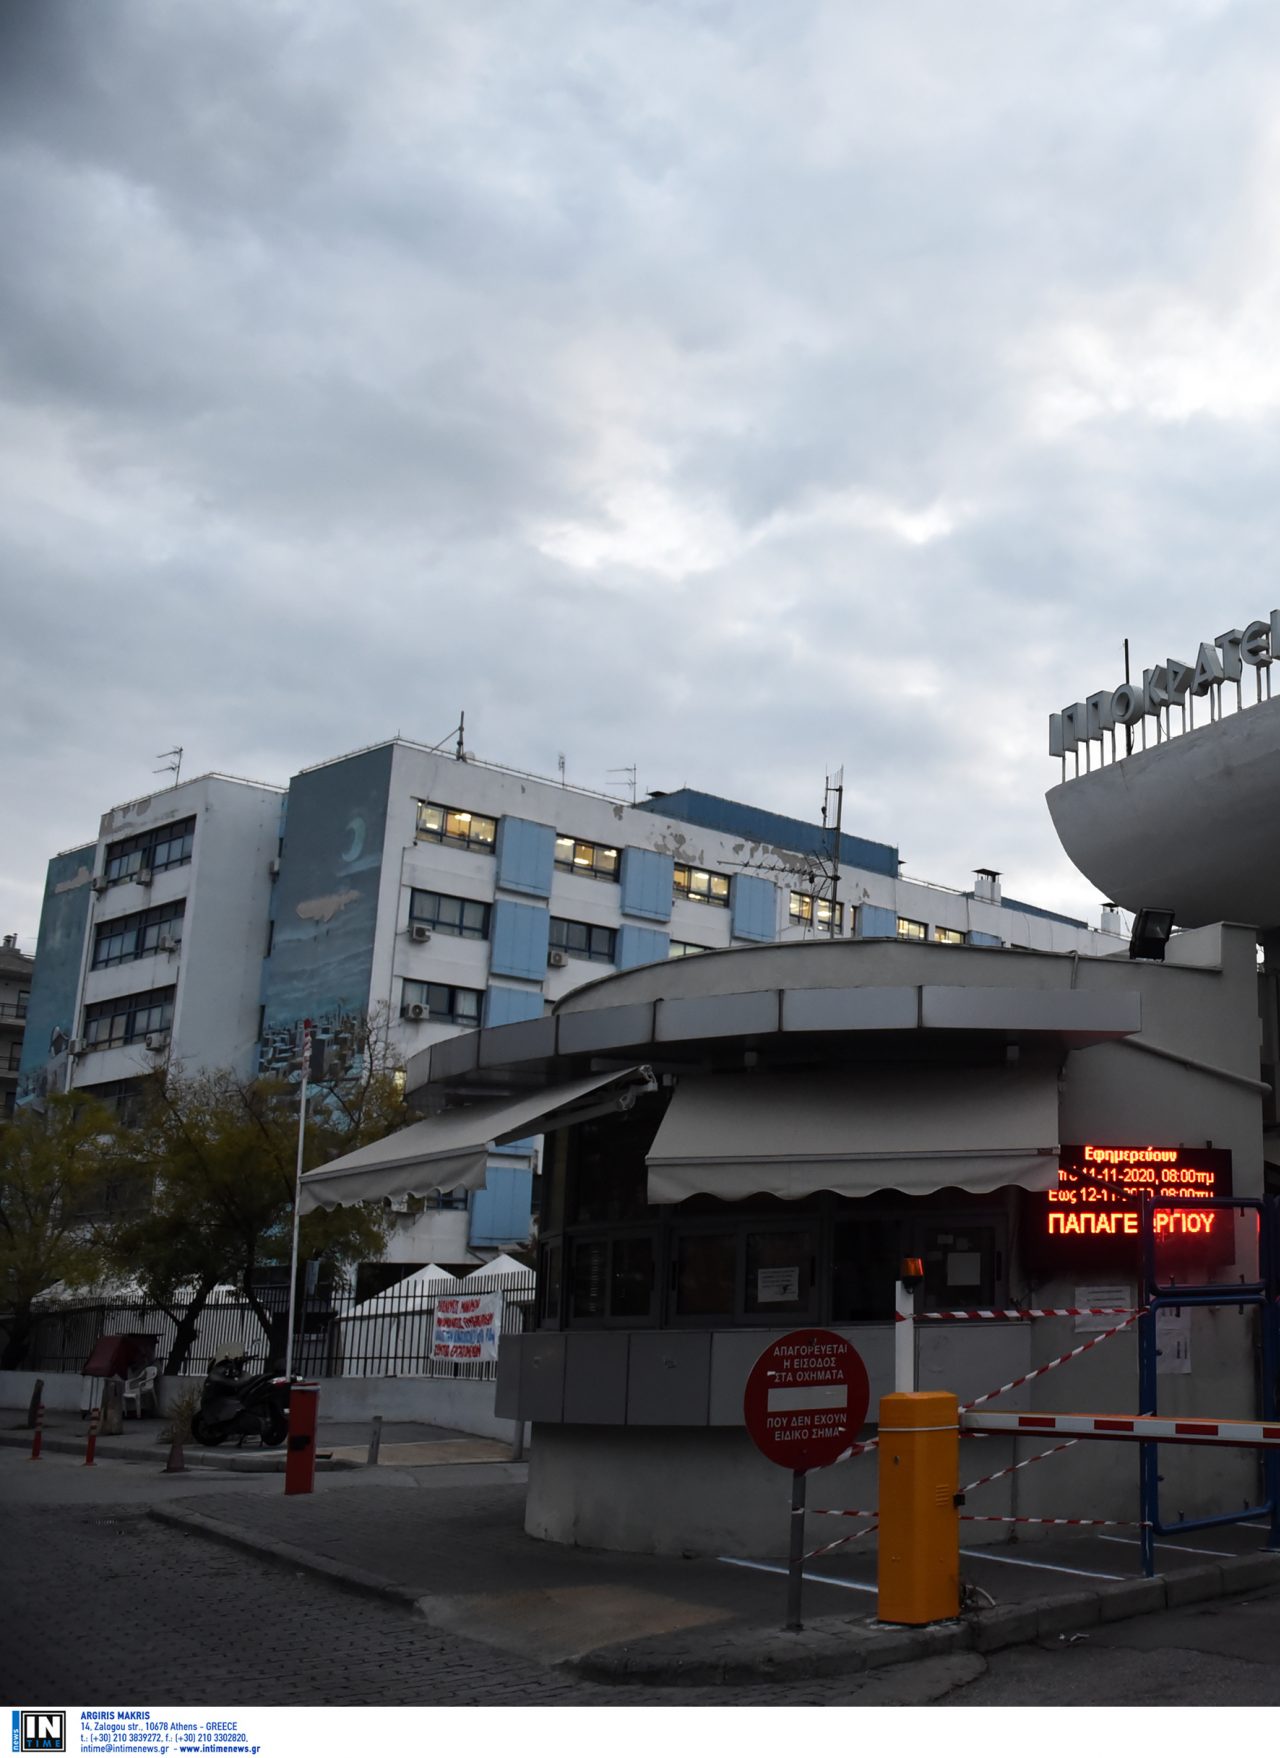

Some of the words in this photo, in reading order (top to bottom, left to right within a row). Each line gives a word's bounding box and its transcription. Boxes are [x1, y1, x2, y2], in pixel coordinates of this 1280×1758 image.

[1084, 1146, 1178, 1164] Εφημερεύουν
[1161, 1168, 1215, 1186] 08:00πμ
[1048, 1213, 1215, 1234] ΠΑΠΑΓΕΡΓΙΟΥ
[773, 1344, 848, 1356] ΑΠΑΓΟΡΕΥΕΤΑΙ
[783, 1359, 791, 1369] Η
[794, 1357, 837, 1368] ΕΙΣΟΔΟΣ
[774, 1371, 794, 1383] ΣΤΑ
[796, 1369, 845, 1382] ΟΧΗΜΑΤΑ
[767, 1417, 788, 1428] ΠΟΥ
[790, 1415, 811, 1426] ΔΕΝ
[814, 1413, 848, 1425] ΕΧΟΥΝ
[774, 1429, 809, 1441] ΕΙΔΙΚΟ
[812, 1427, 840, 1439] ΣΗΜΑ
